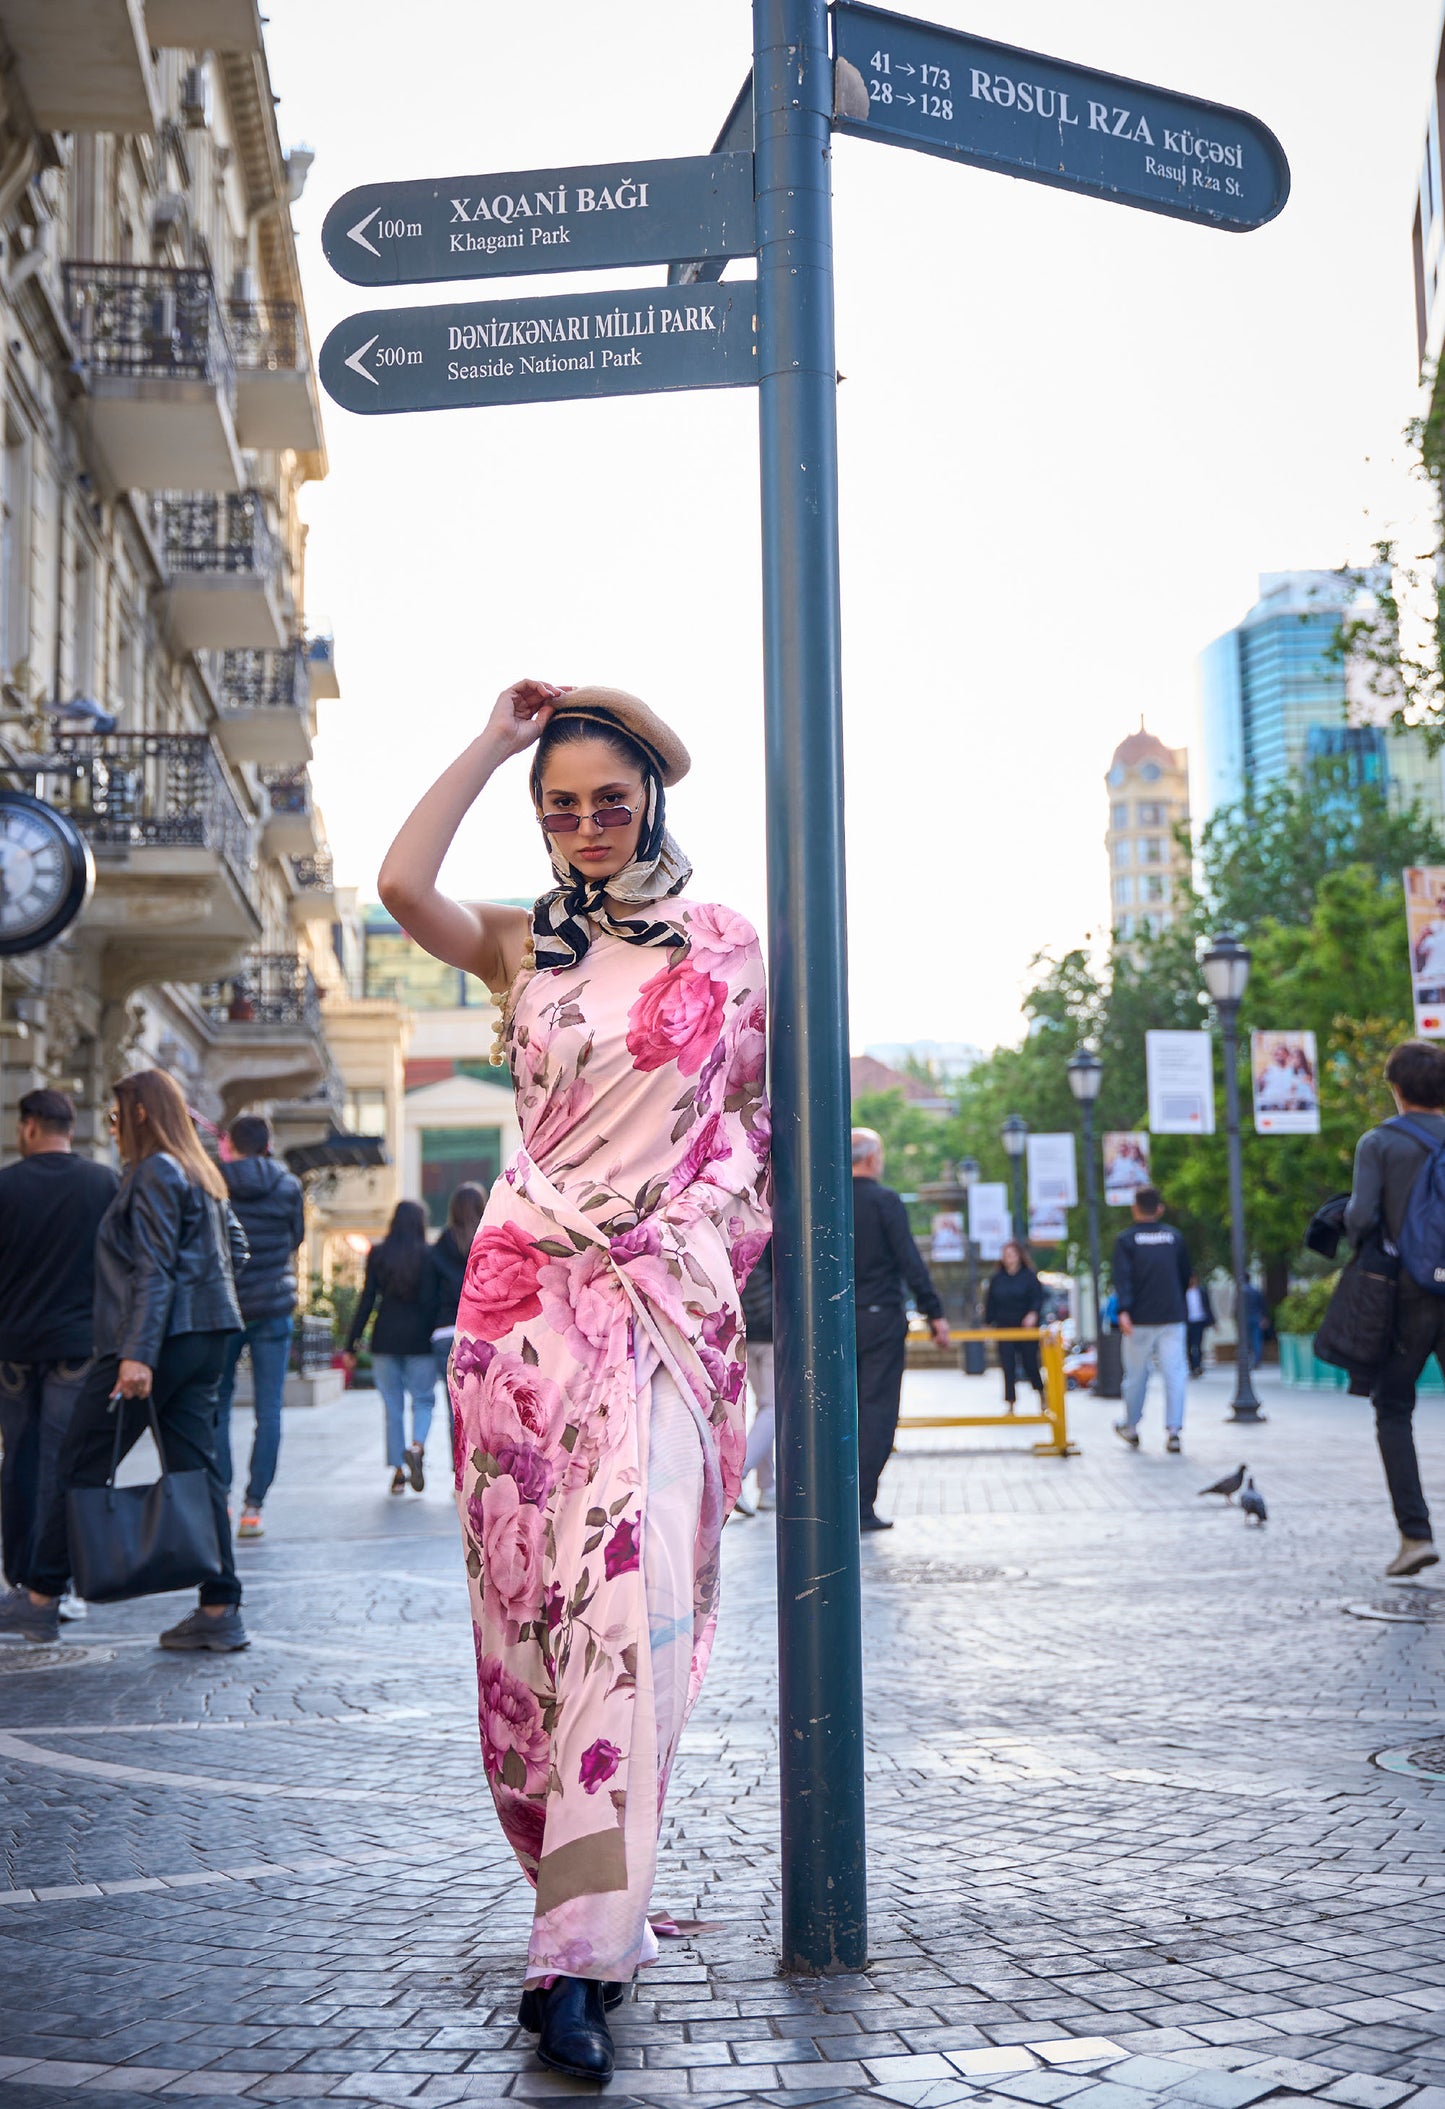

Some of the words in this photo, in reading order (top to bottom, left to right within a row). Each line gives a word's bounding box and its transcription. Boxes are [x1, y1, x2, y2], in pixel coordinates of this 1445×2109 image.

[870, 51, 891, 75] 41
[919, 64, 952, 91] 173
[869, 80, 893, 104] 28
[920, 94, 954, 121] 128
[969, 69, 1079, 126] RƏSUL
[1087, 101, 1155, 146] RZA
[1164, 130, 1243, 170] KÜÇƏSİ
[1145, 156, 1187, 184] Rasul
[1193, 169, 1221, 191] Rza
[1226, 178, 1244, 198] St.
[449, 185, 568, 224] XAQANİ
[576, 178, 649, 213] BAĞI
[377, 219, 423, 239] 100m
[449, 226, 524, 254] Khagani
[531, 225, 571, 246] Park
[448, 317, 590, 351] DƏNİZKƏNARI
[595, 305, 656, 339] MİLLİ
[661, 306, 717, 333] PARK
[376, 347, 424, 367] 500m
[447, 357, 514, 380] Seaside
[519, 351, 596, 374] National
[601, 347, 643, 368] Park
